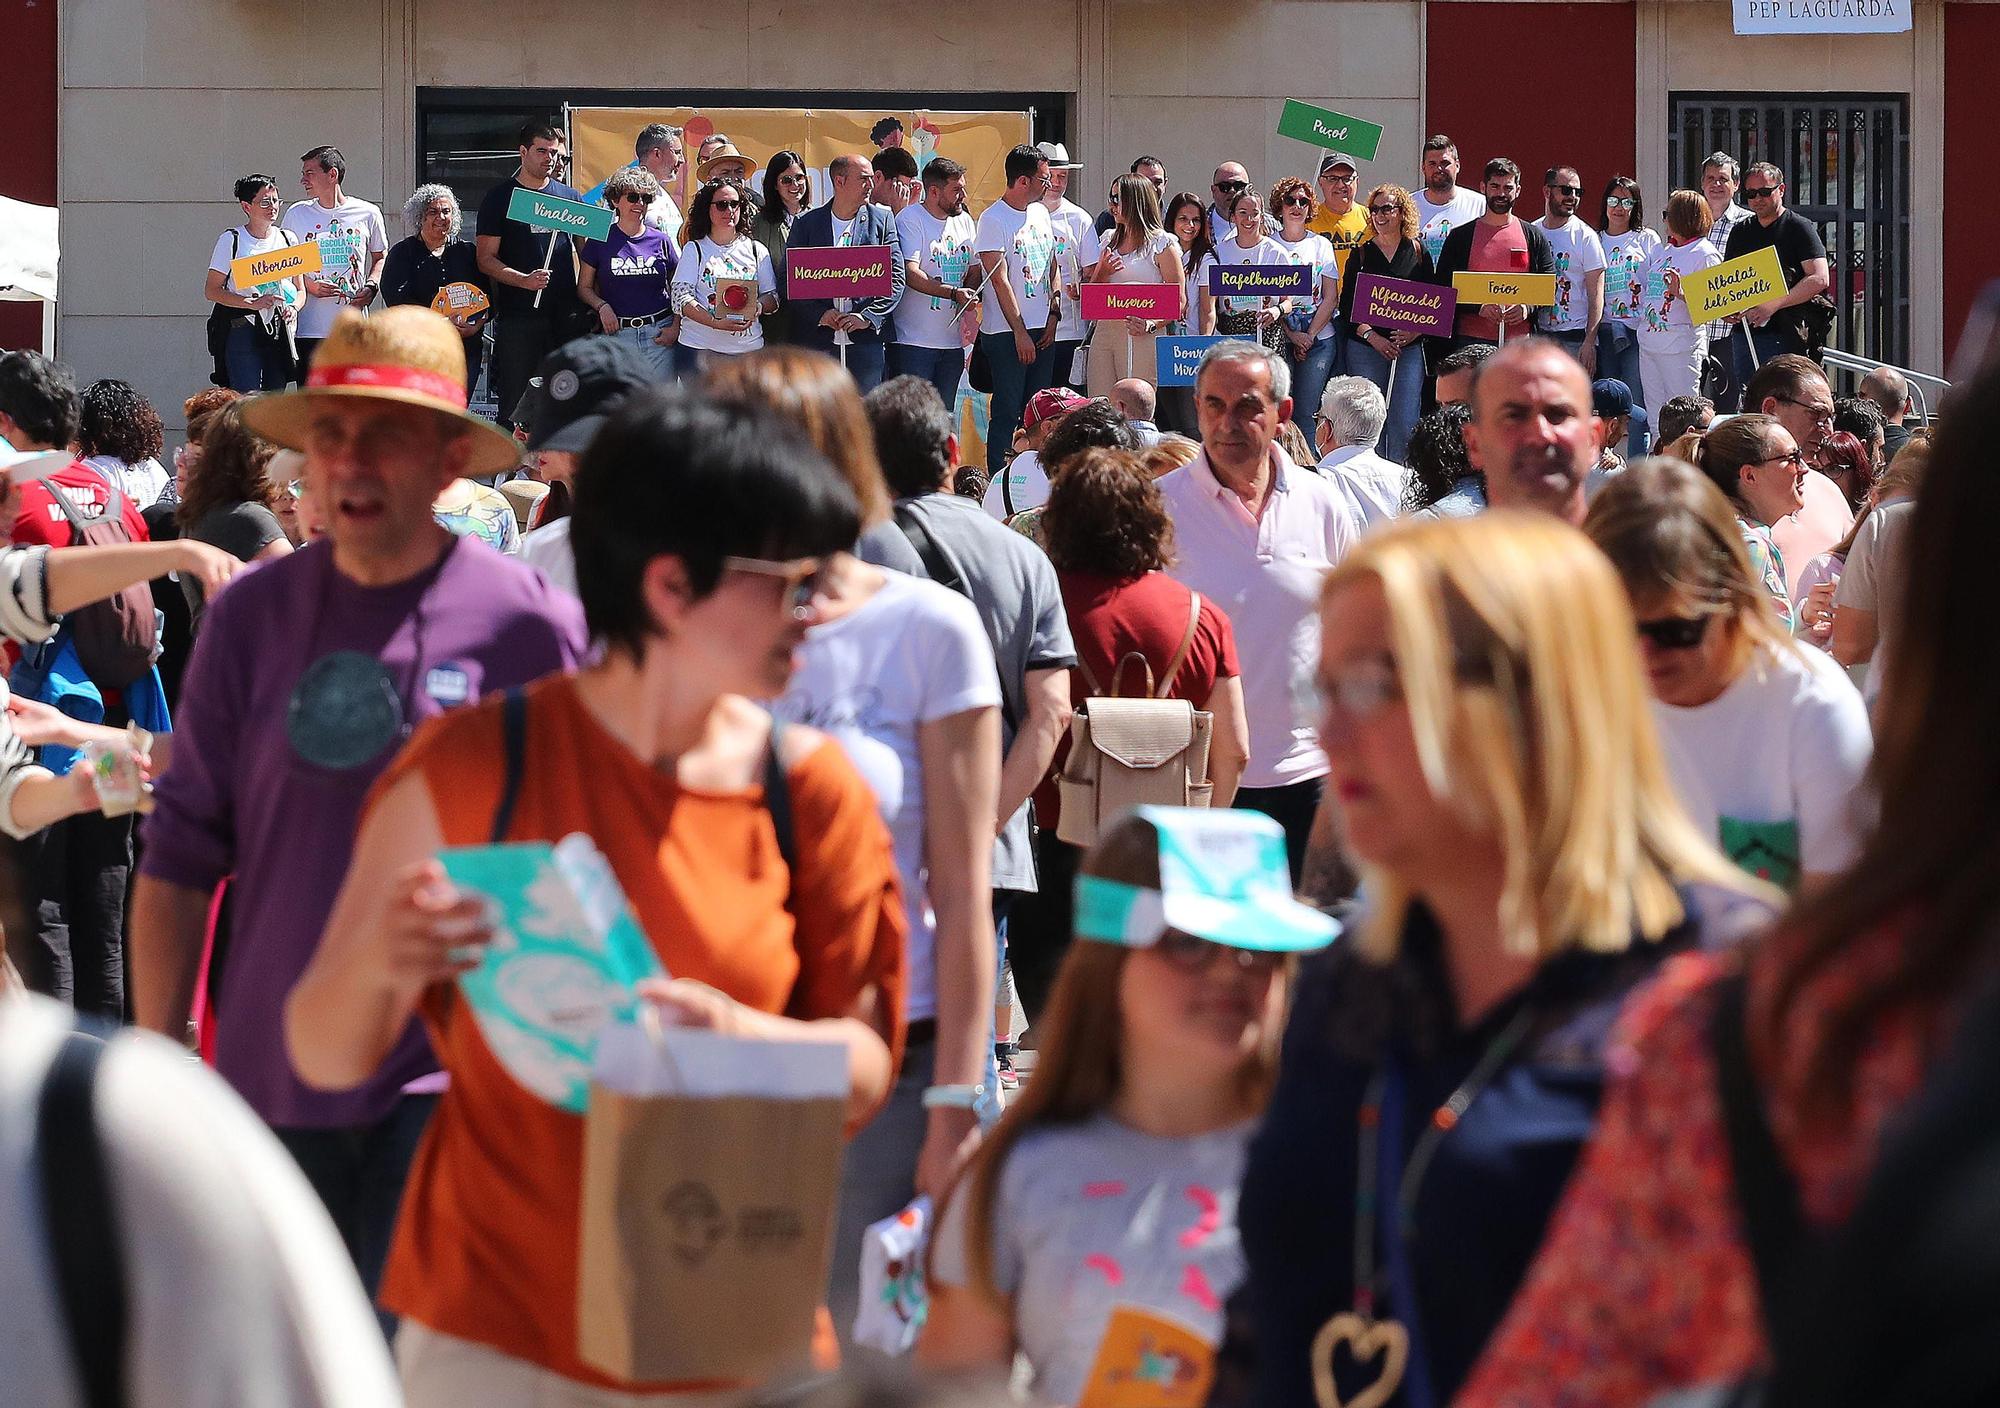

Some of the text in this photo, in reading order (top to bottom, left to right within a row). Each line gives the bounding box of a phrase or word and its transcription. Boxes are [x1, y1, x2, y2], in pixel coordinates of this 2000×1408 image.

[1750, 0, 1895, 18] PEP LAGUARDA
[1313, 119, 1348, 140] Puçol
[534, 202, 589, 226] Vinalesa
[251, 256, 302, 276] Alboraia
[795, 263, 885, 283] Massamagrell
[1221, 271, 1301, 290] Rafelbunyol
[1489, 281, 1520, 295] Foios
[1708, 266, 1757, 291] Albalat
[1107, 294, 1155, 308] Museros
[1371, 286, 1442, 309] Alfara del
[1703, 279, 1772, 311] dels Sorells
[1369, 302, 1439, 325] Patriarca
